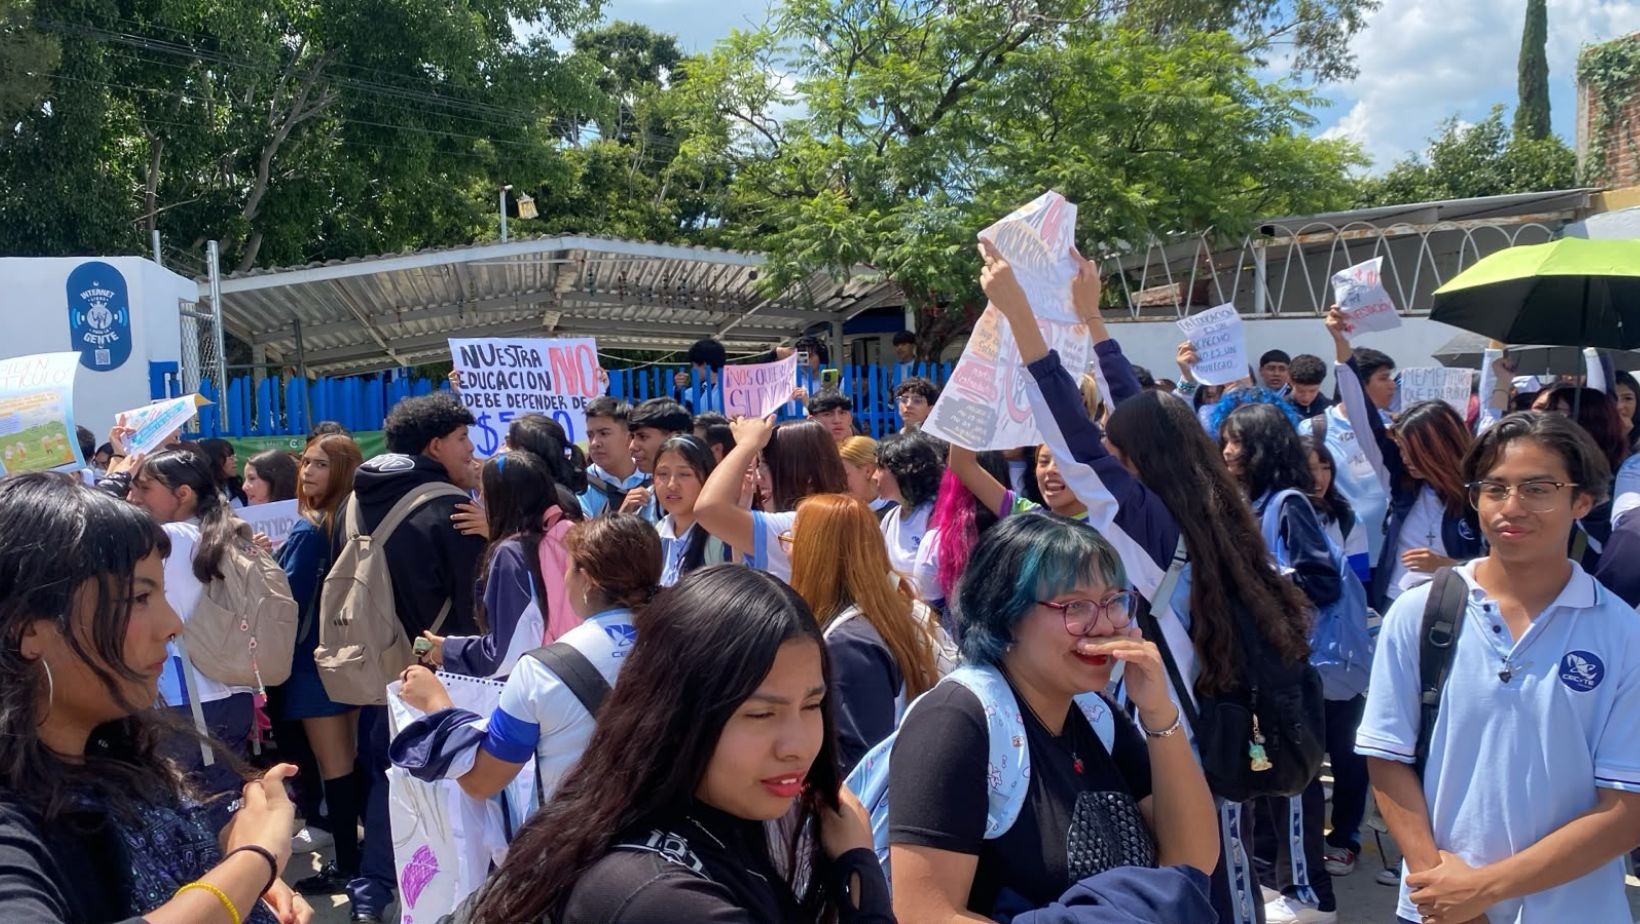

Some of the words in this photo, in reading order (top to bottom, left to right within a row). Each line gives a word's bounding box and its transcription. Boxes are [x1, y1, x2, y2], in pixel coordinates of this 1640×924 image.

[80, 288, 115, 300] INTERNET
[83, 331, 119, 345] GENTE
[460, 344, 543, 369] NUESTRA
[459, 370, 551, 391] EDUCACION
[548, 343, 599, 398] NO
[464, 393, 501, 409] DEBE
[507, 393, 568, 411] DEPENDER
[572, 396, 588, 410] DE
